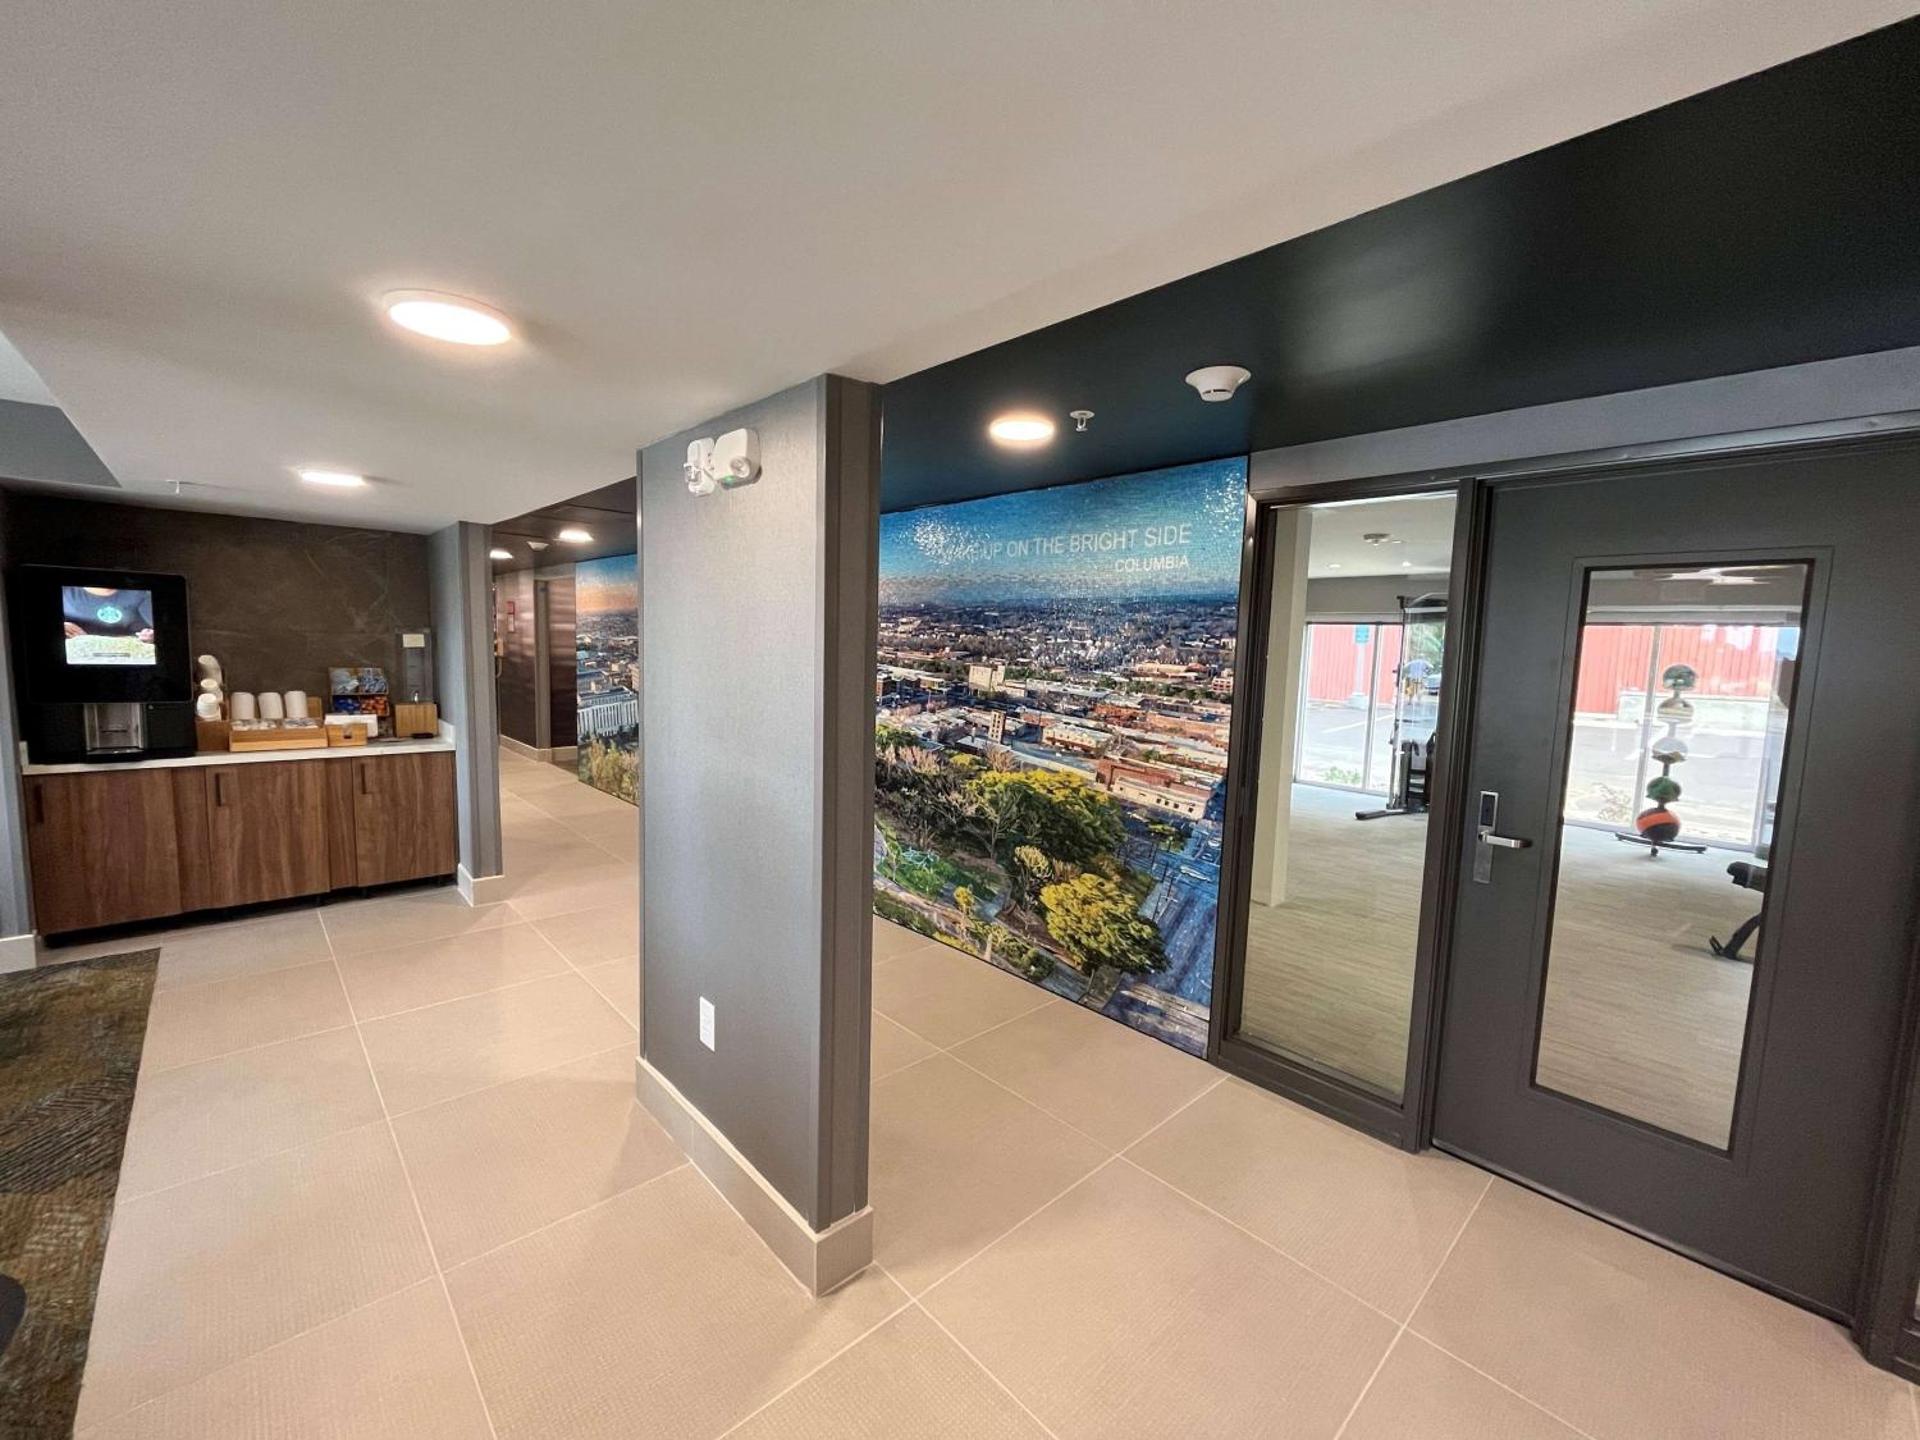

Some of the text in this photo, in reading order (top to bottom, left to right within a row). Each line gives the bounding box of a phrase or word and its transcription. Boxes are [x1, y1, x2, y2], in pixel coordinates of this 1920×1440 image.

[983, 541, 1002, 560] UP
[1006, 540, 1028, 558] ON
[1033, 535, 1065, 555] THE
[1069, 529, 1138, 553] BRIGHT
[1144, 522, 1192, 548] SIDE
[1115, 554, 1190, 573] COLUMBIA
